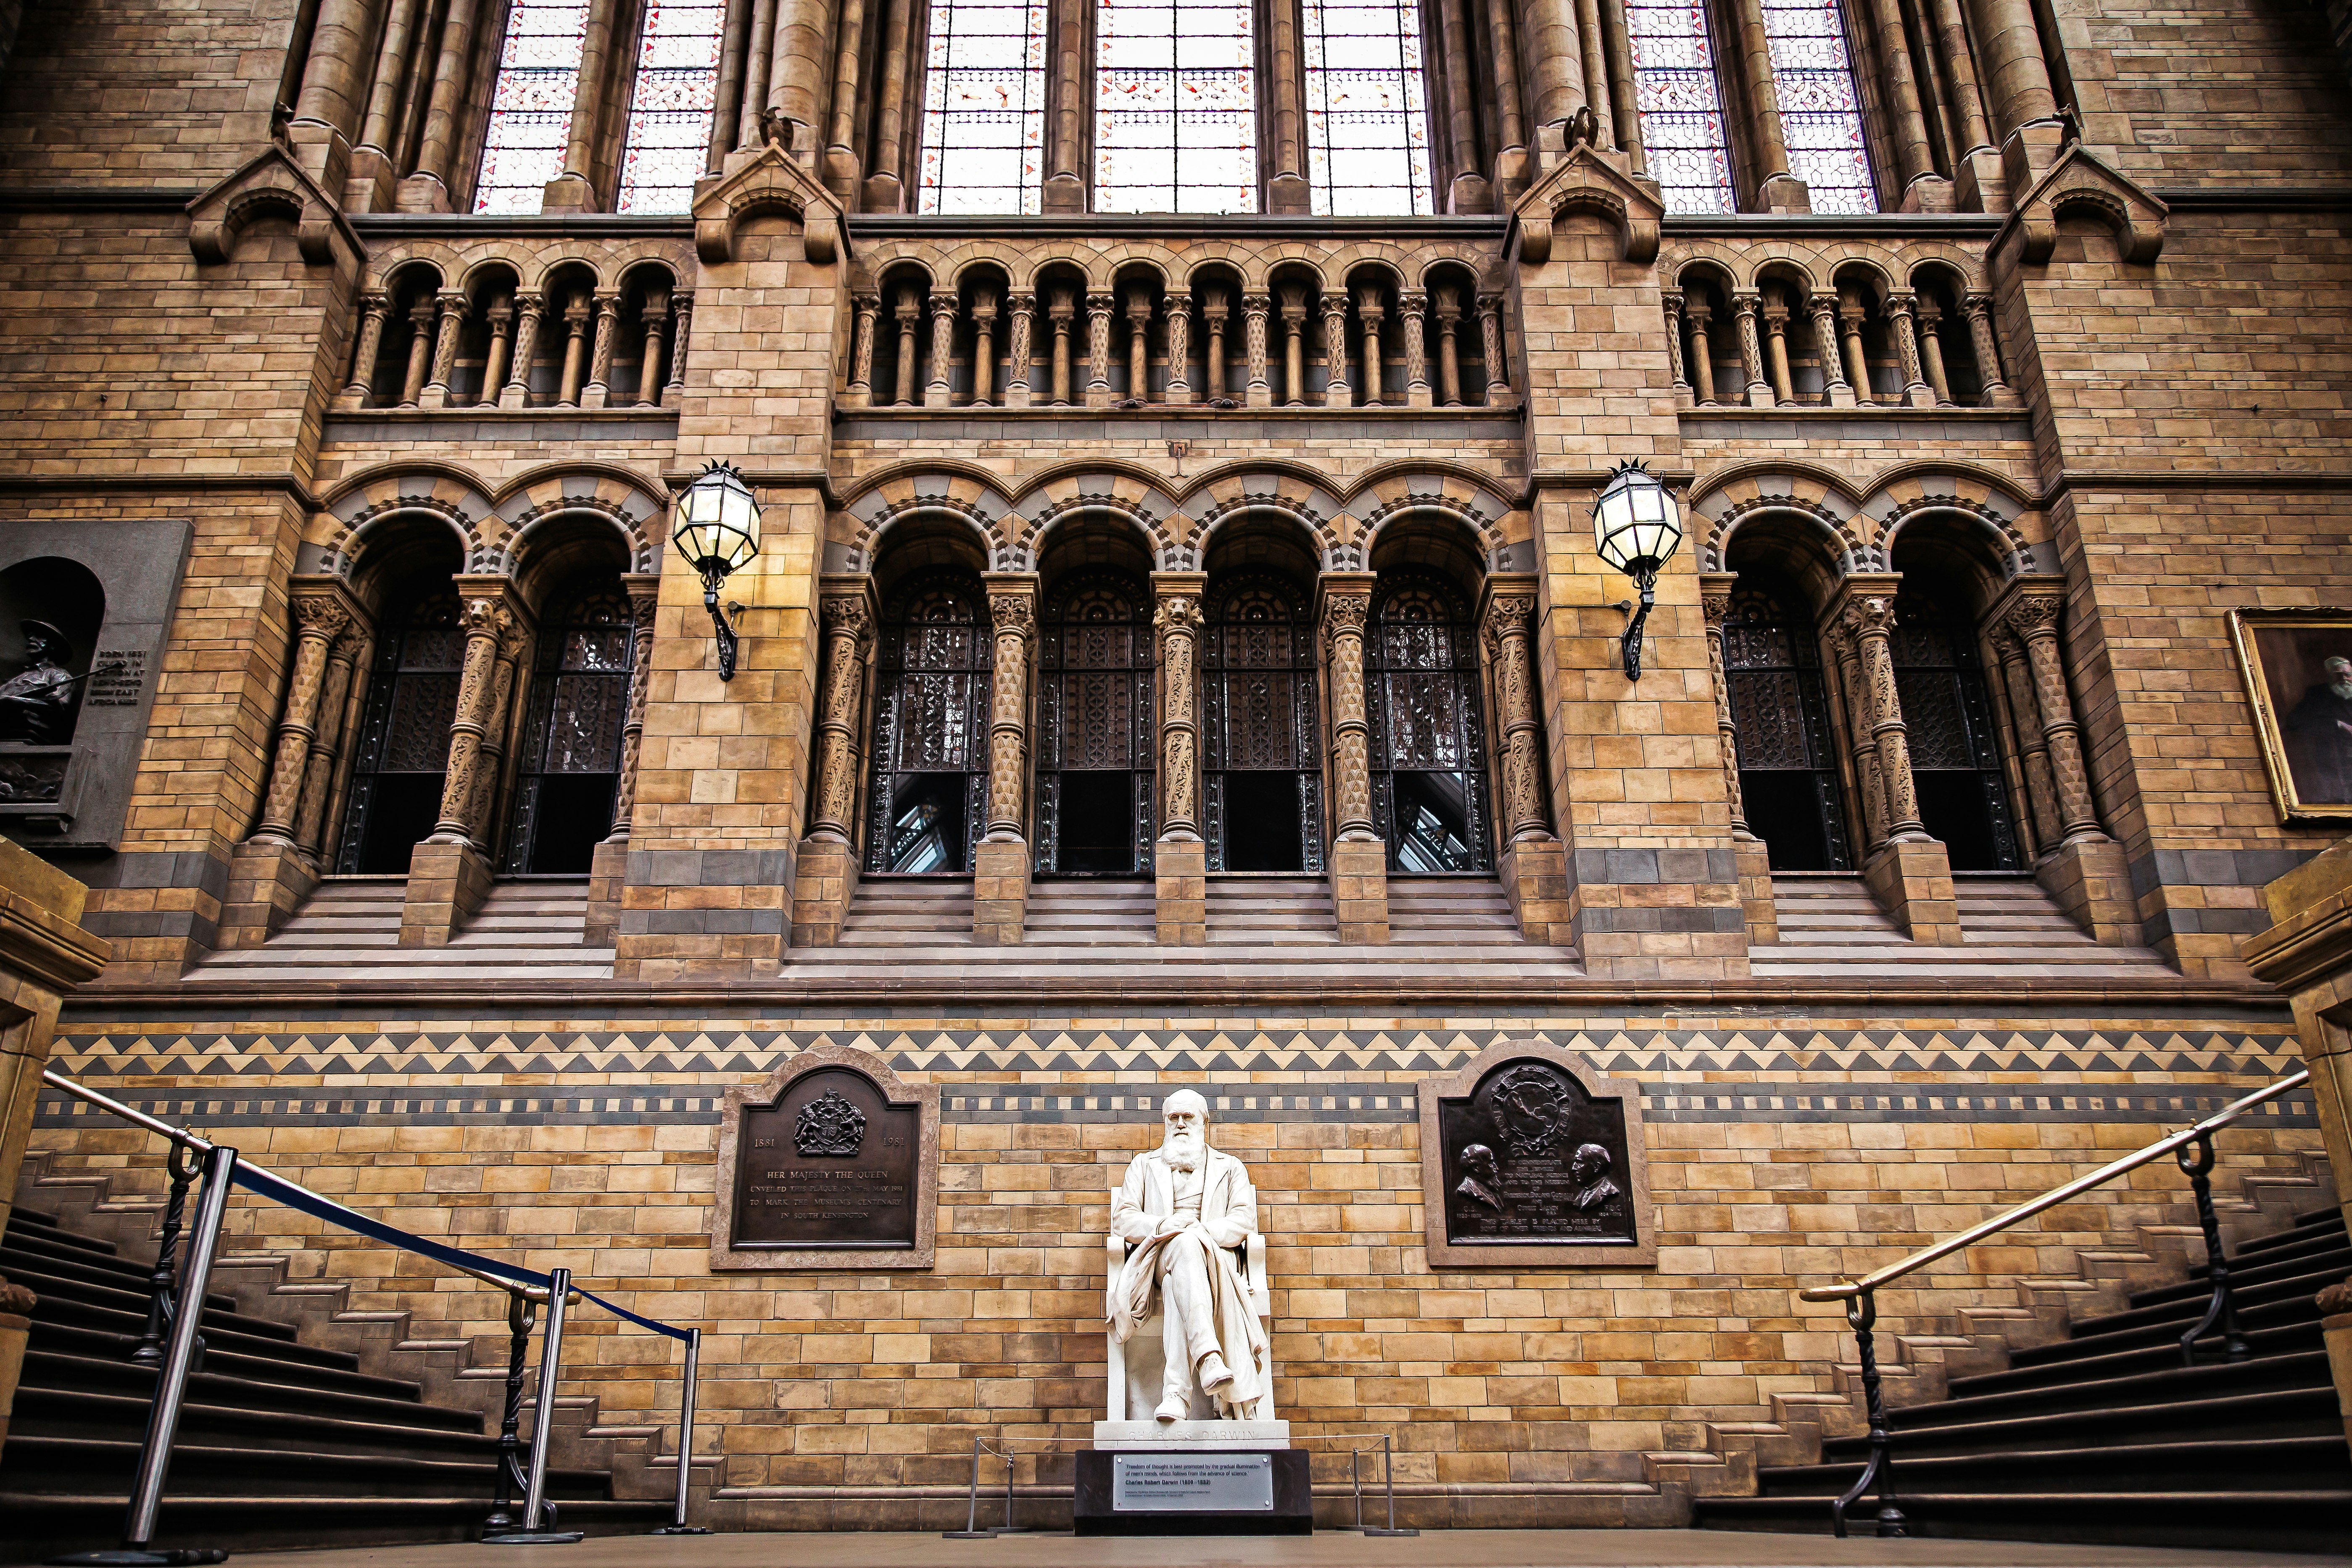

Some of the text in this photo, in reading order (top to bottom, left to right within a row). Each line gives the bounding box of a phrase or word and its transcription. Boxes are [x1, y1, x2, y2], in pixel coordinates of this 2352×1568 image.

[755, 1138, 775, 1147] 1881
[883, 1137, 905, 1146] 1981
[791, 1171, 831, 1181] MAJESTY
[1129, 1431, 1254, 1440] CHARLES DARWIN
